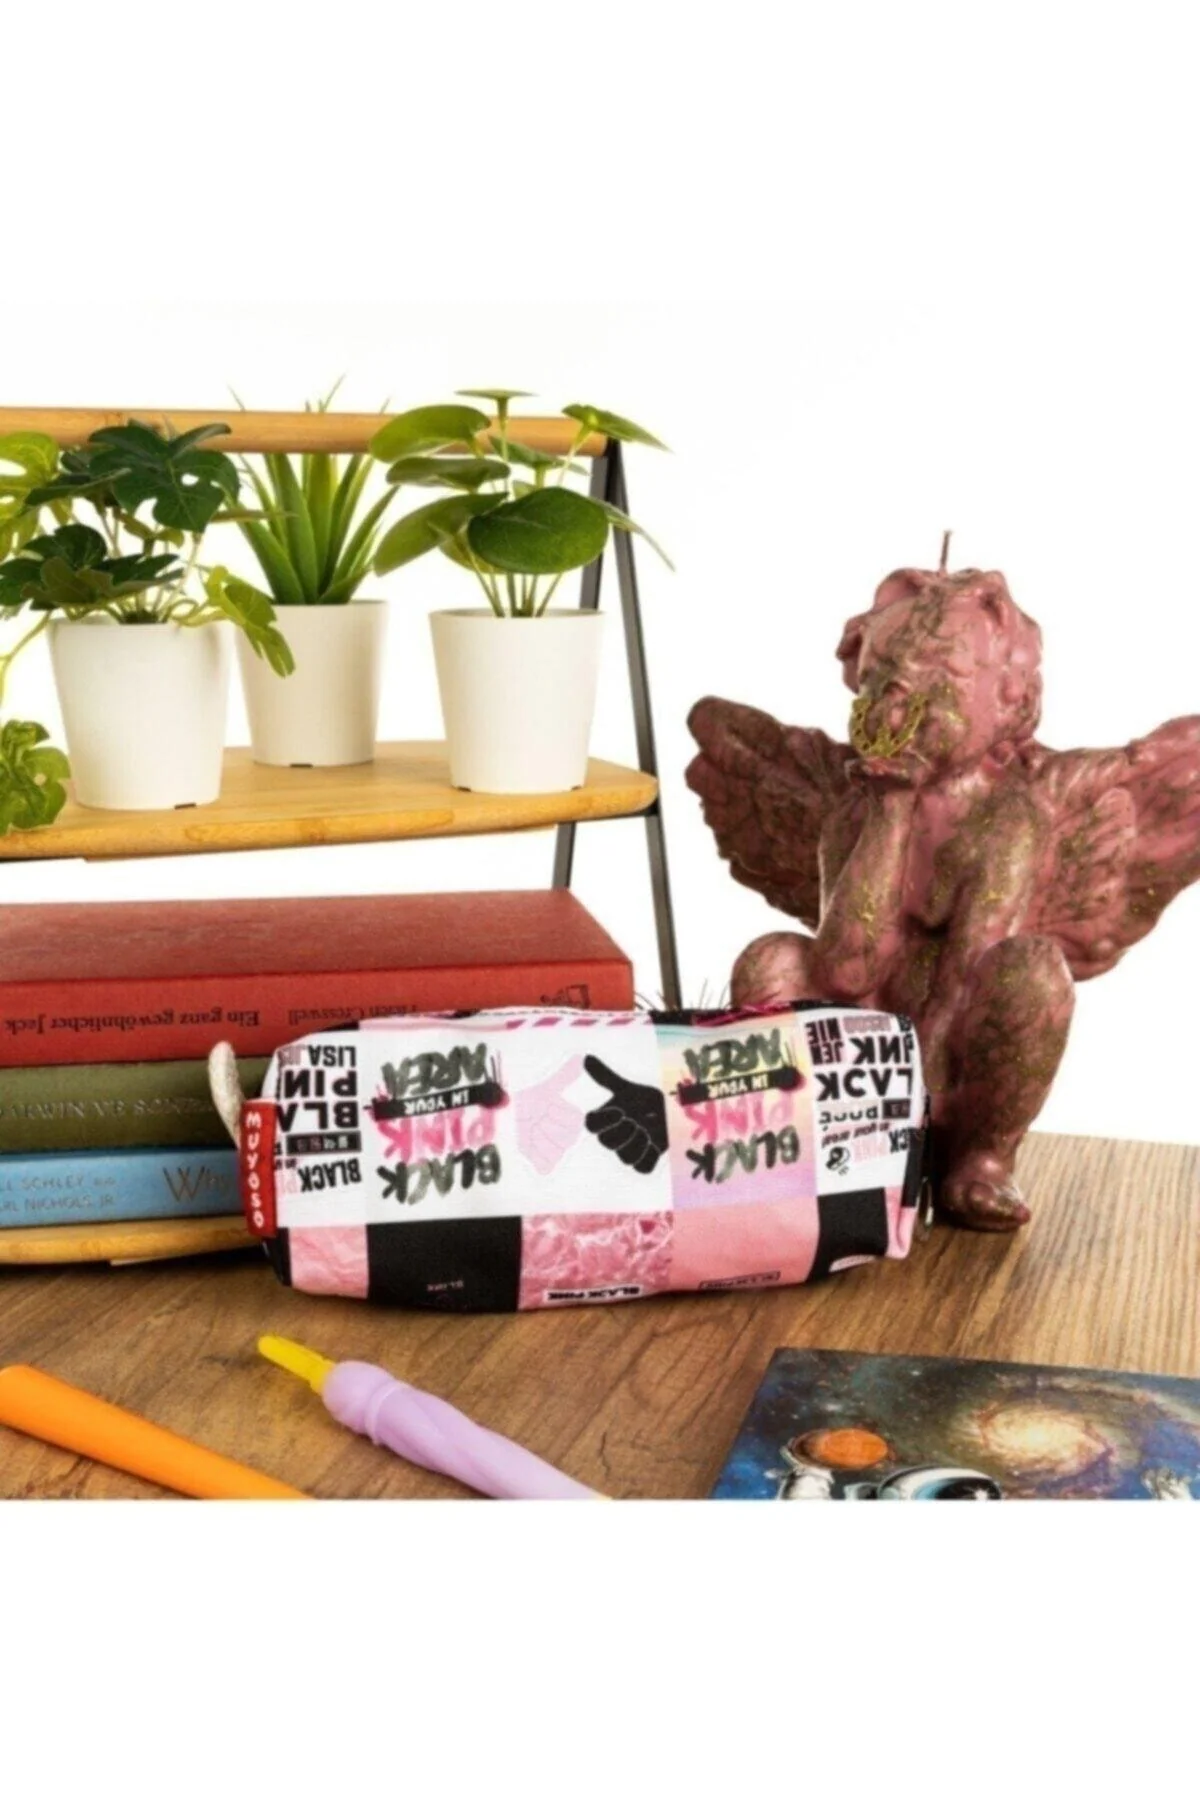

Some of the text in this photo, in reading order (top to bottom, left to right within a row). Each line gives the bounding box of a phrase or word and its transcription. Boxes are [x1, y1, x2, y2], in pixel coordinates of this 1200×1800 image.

[180, 1007, 223, 1026] ganz
[227, 1010, 261, 1027] Ein
[307, 1045, 356, 1067] LISA
[381, 1042, 488, 1098] AREA
[683, 1028, 782, 1084] AREA
[708, 1079, 746, 1099] YOUR
[404, 1095, 445, 1114] YOUR
[686, 1125, 800, 1185] BLACK
[300, 1158, 362, 1193] BLACK
[376, 1143, 502, 1206] BLACK
